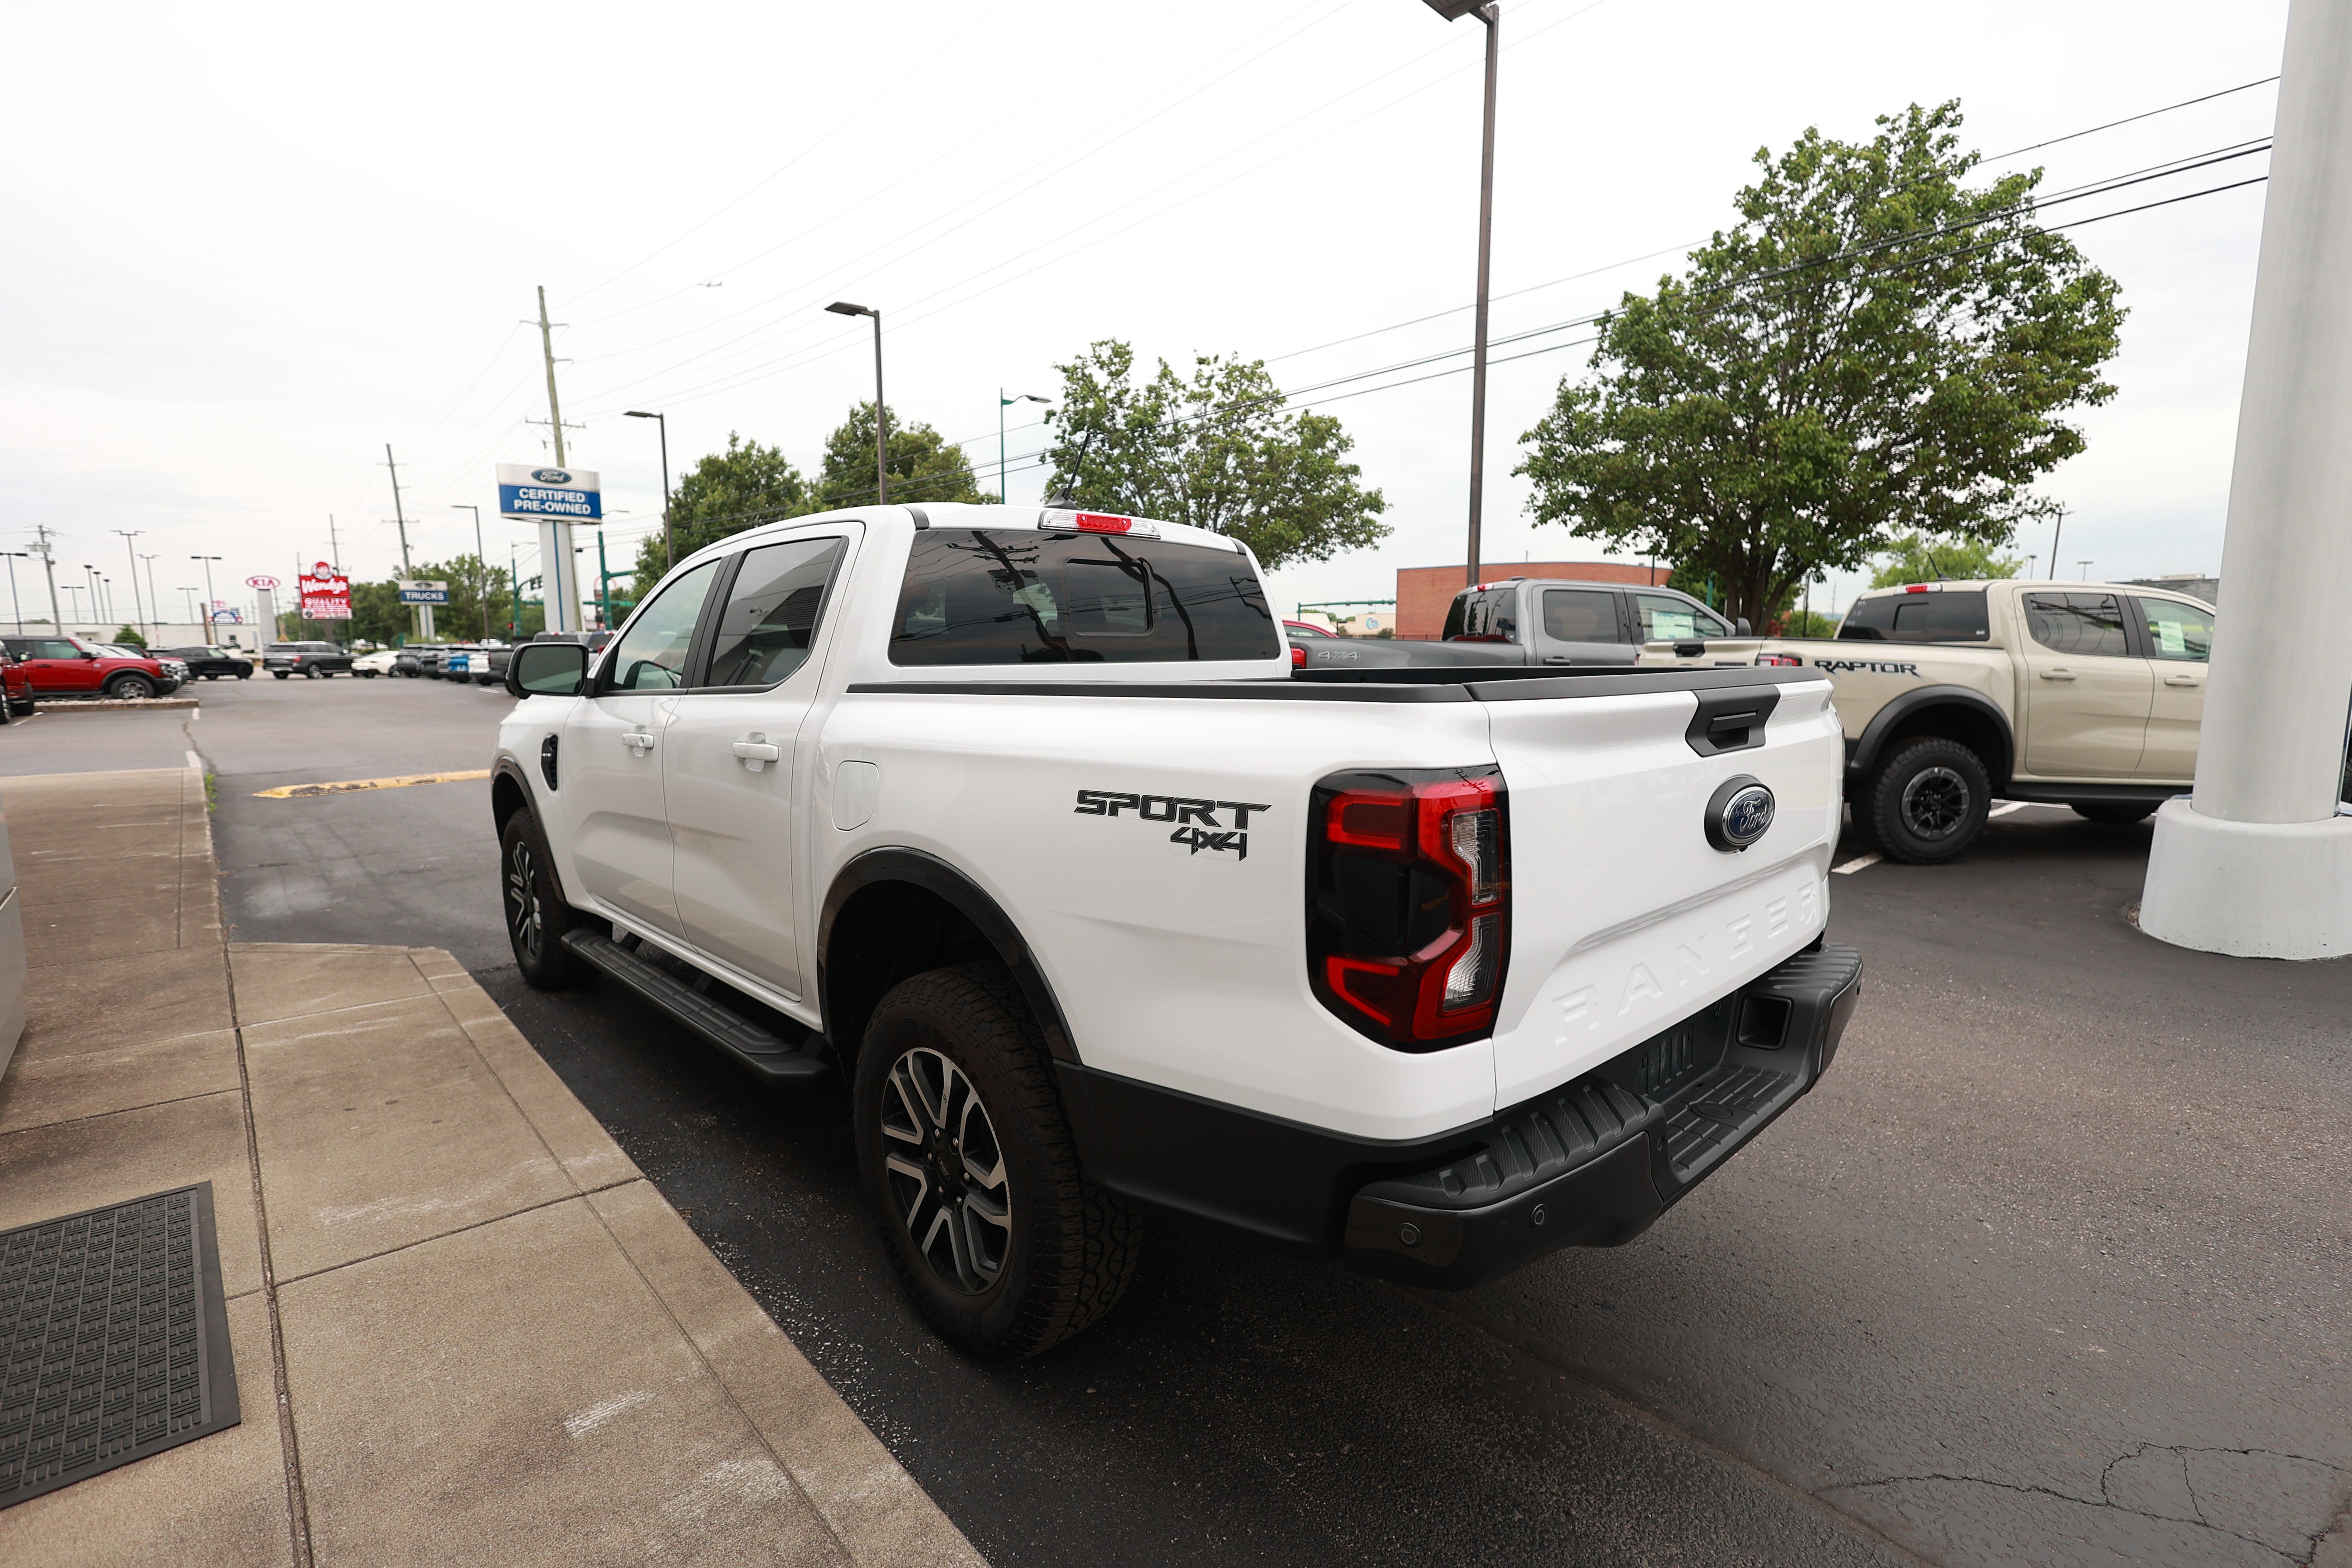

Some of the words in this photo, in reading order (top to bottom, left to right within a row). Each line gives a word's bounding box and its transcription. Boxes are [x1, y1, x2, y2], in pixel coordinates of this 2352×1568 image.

[539, 470, 564, 481] Ford
[518, 488, 585, 503] CERTIFIED
[514, 499, 591, 514] PRE-OWNED
[301, 578, 347, 594] Wendy's
[404, 591, 444, 600] TRUCKS
[1814, 658, 1926, 683] RAPTOR
[1074, 790, 1272, 830] SPORT
[1739, 799, 1767, 833] Ford
[1170, 826, 1247, 861] 4x4
[1551, 881, 1819, 1045] RANGER
